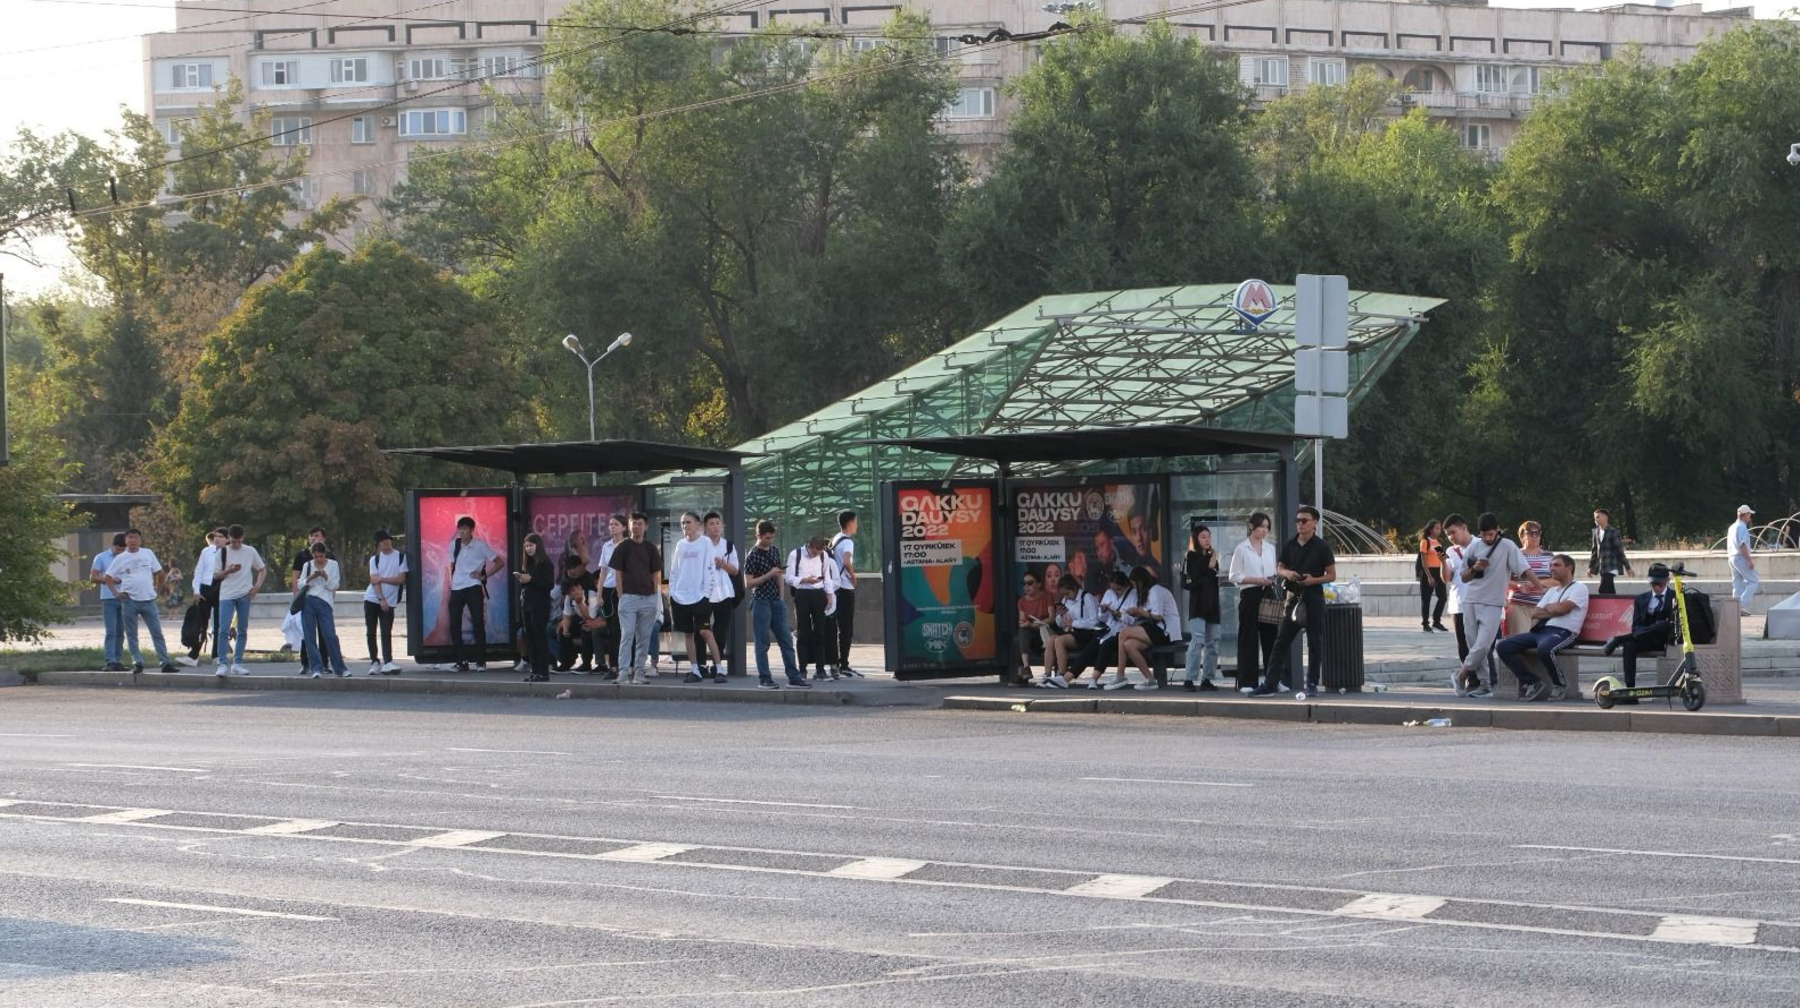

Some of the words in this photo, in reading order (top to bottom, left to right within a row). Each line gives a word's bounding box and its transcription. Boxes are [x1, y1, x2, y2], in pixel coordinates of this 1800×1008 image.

[901, 509, 981, 525] DAUYSY
[1018, 507, 1081, 522] DAUYSY
[902, 525, 949, 537] 2022
[1018, 522, 1054, 534] 2022
[903, 551, 927, 559] 17:00
